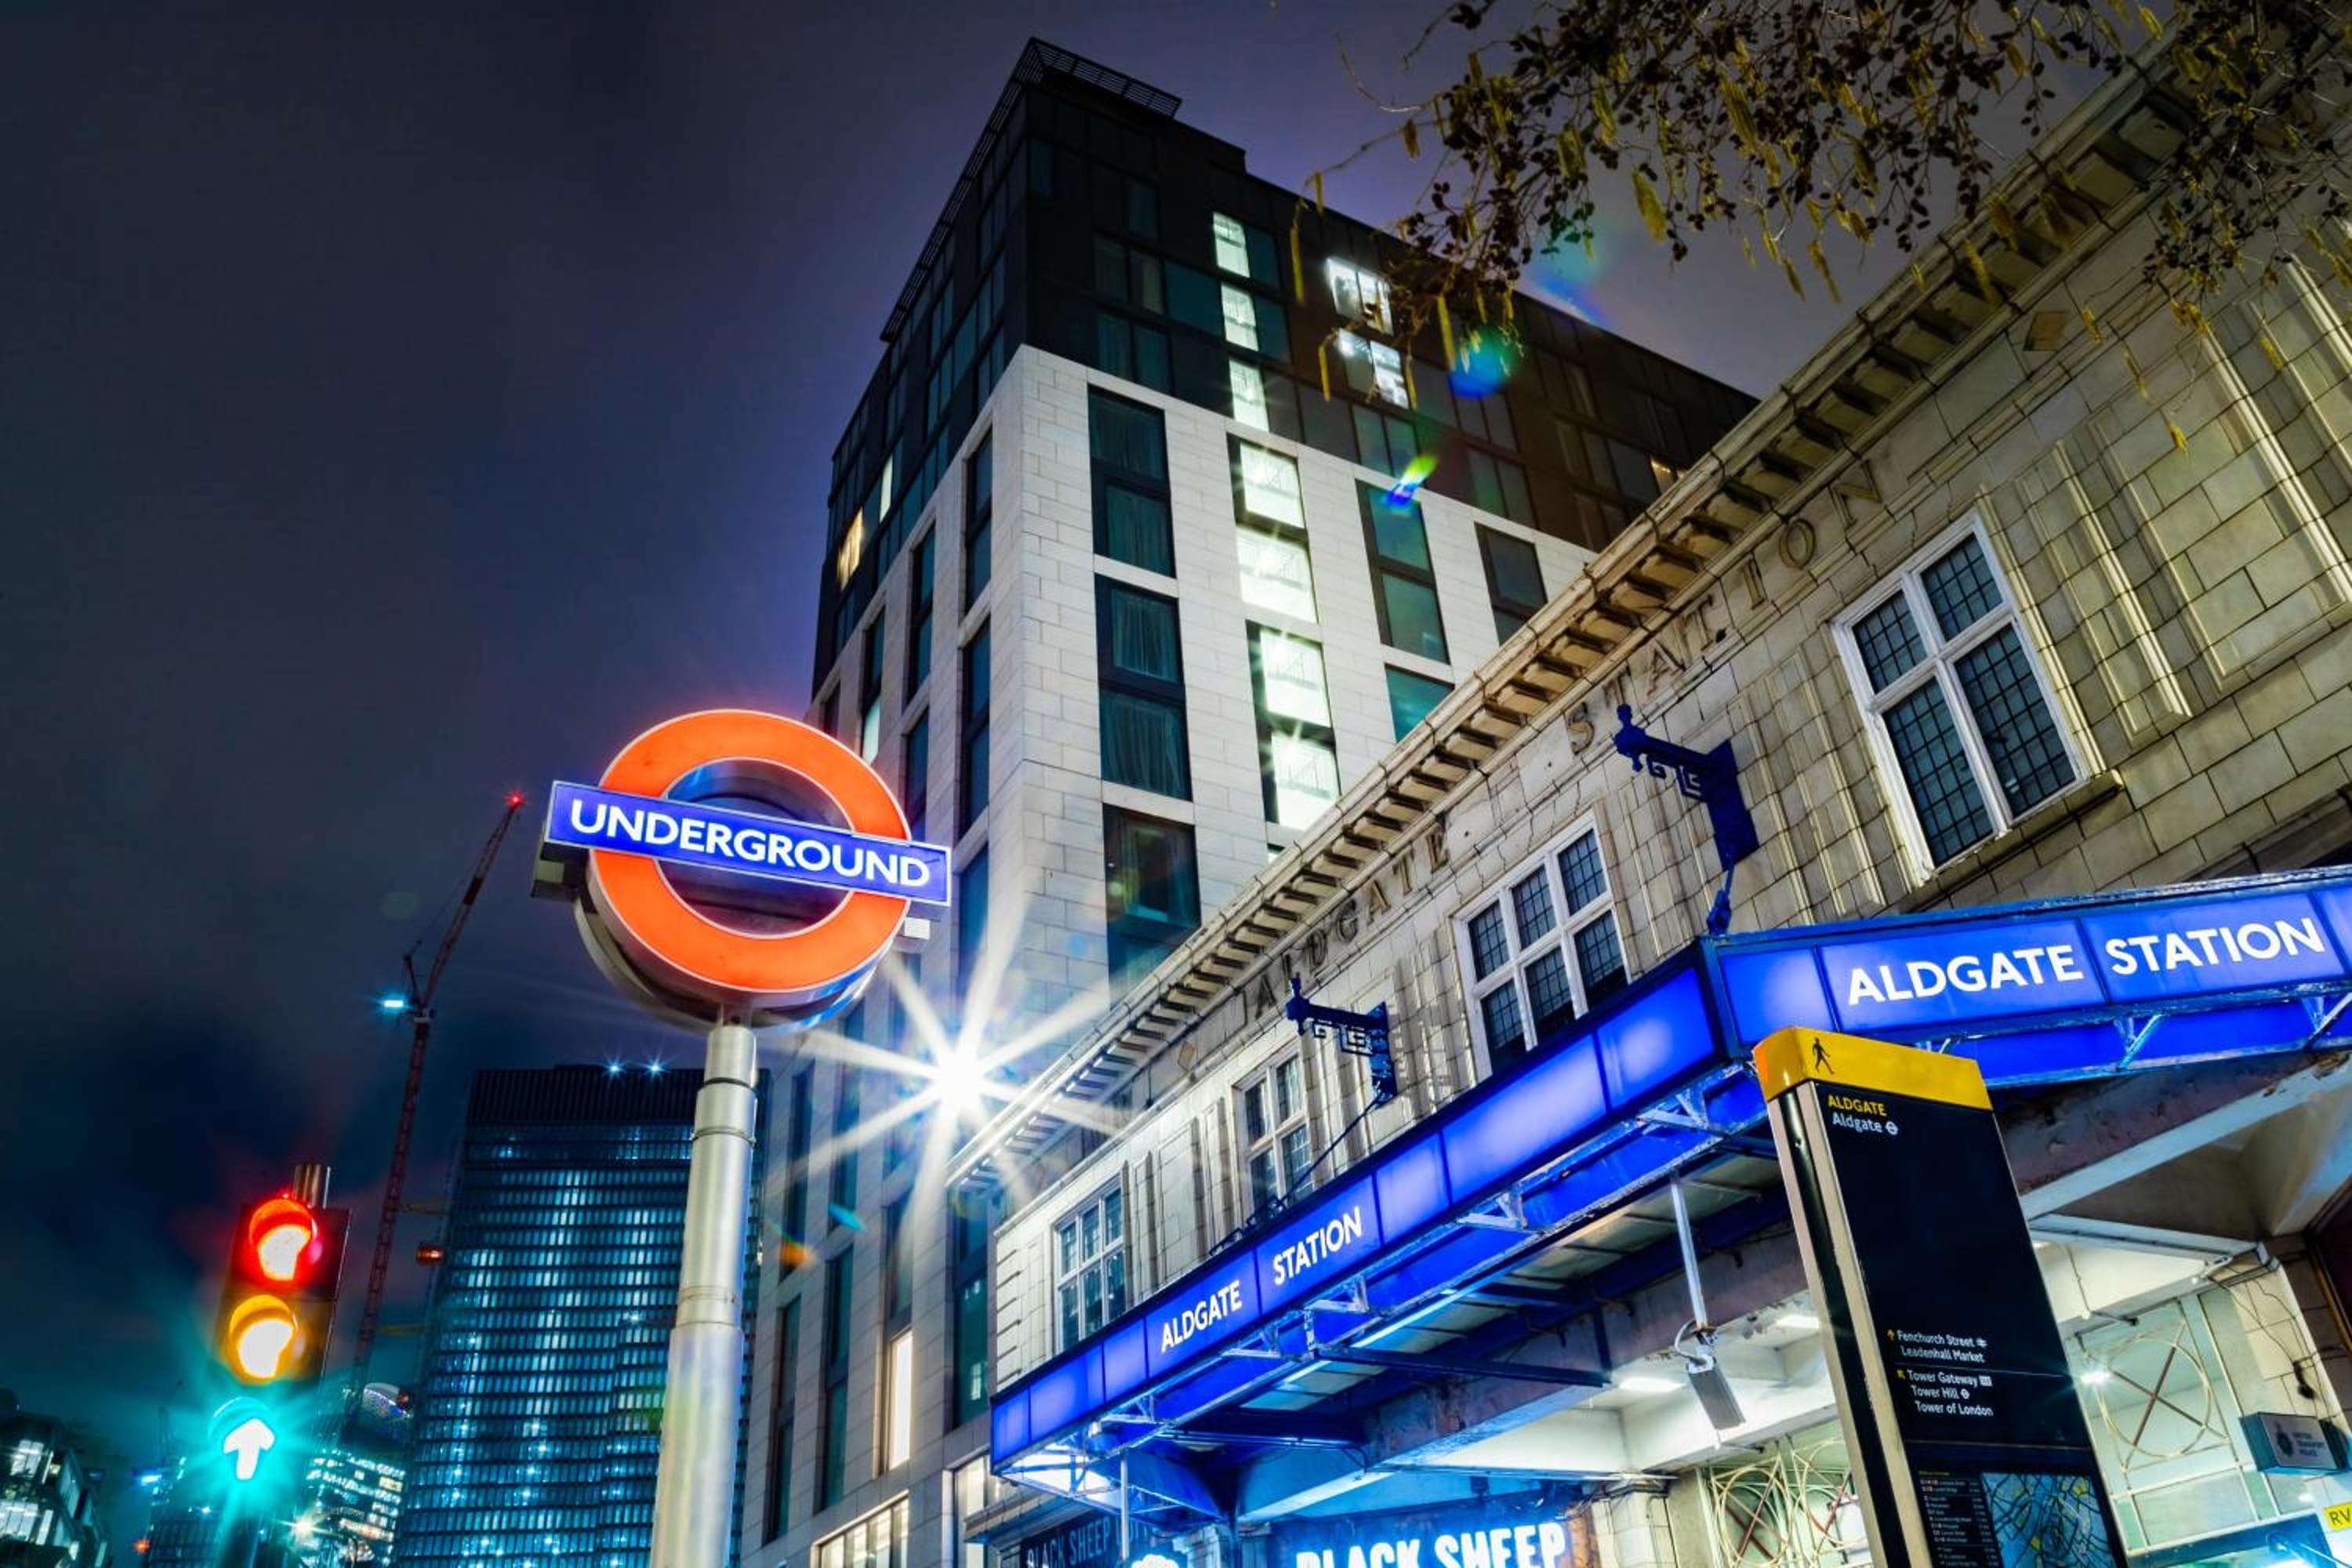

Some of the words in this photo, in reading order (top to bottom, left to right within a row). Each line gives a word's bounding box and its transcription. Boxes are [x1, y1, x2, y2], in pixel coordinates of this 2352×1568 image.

[570, 799, 931, 887] UNDERGROUND
[1848, 944, 2084, 1006] ALDGATE
[2105, 917, 2325, 975] STATION
[1828, 1094, 1887, 1116] ALDGATE
[1832, 1111, 1883, 1133] Aldgate
[1161, 1279, 1242, 1352] ALDGATE
[1273, 1206, 1363, 1286] STATION
[1896, 1330, 1946, 1345] Fenchurch
[1946, 1334, 1975, 1348] Street
[1900, 1345, 1953, 1361] Leadenhall
[1952, 1349, 1986, 1363] Market
[1907, 1370, 1936, 1382] Tower
[1937, 1371, 1978, 1388] Gateway
[1911, 1384, 1940, 1398] Tower
[1940, 1387, 1961, 1399] Hill
[1915, 1399, 1944, 1414] Tower
[1946, 1403, 1957, 1414] of
[1958, 1403, 1994, 1417] London
[1069, 1516, 1112, 1566] SHEEP
